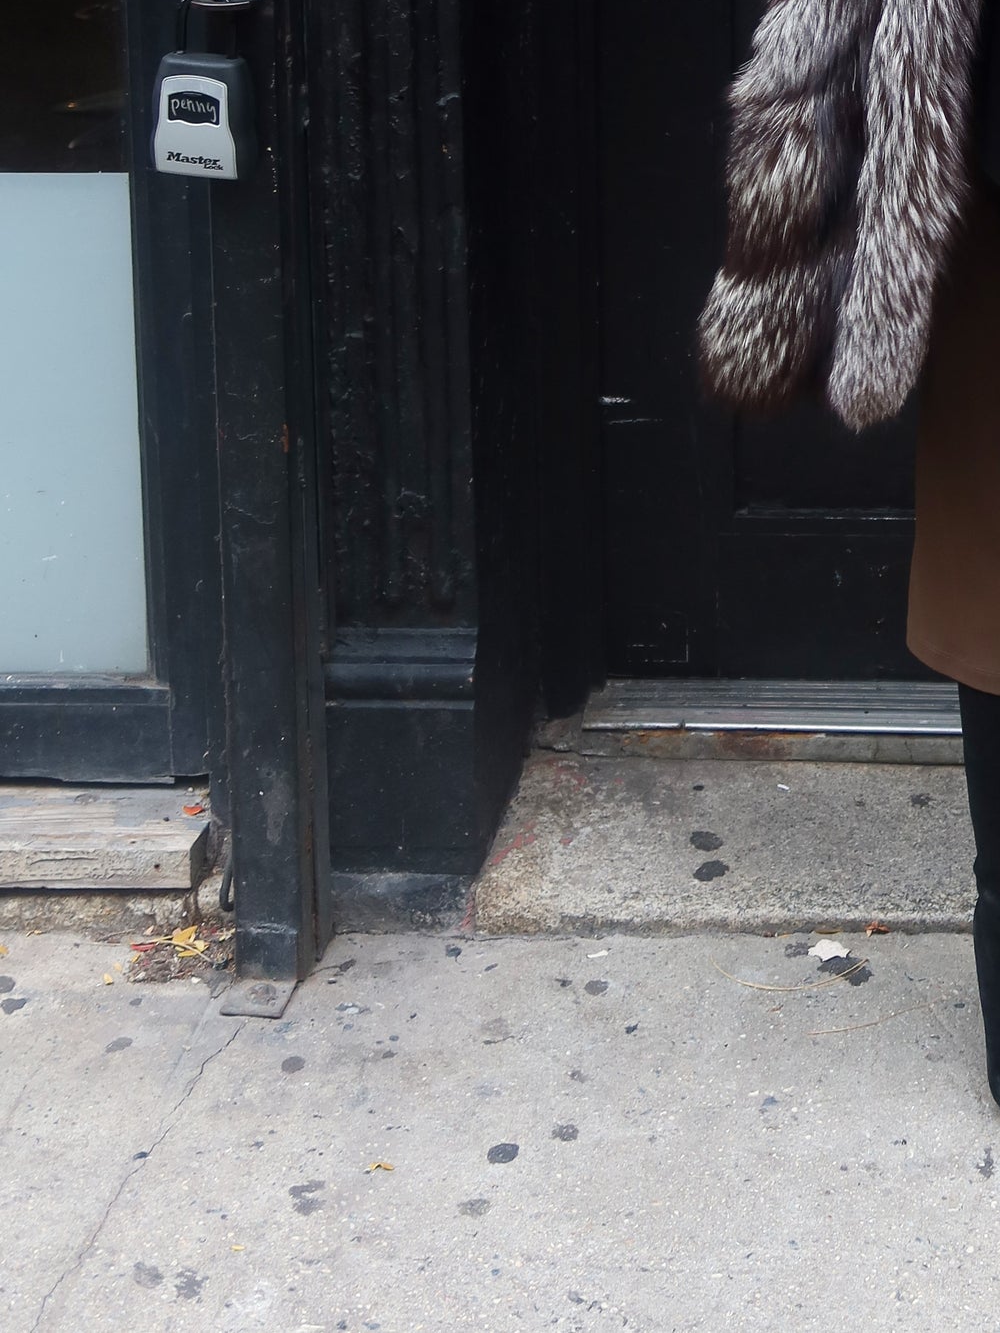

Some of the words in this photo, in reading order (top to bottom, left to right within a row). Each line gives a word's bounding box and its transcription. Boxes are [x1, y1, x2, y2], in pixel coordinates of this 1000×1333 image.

[170, 98, 217, 123] penny
[166, 151, 221, 166] Master
[203, 163, 224, 171] Lock
